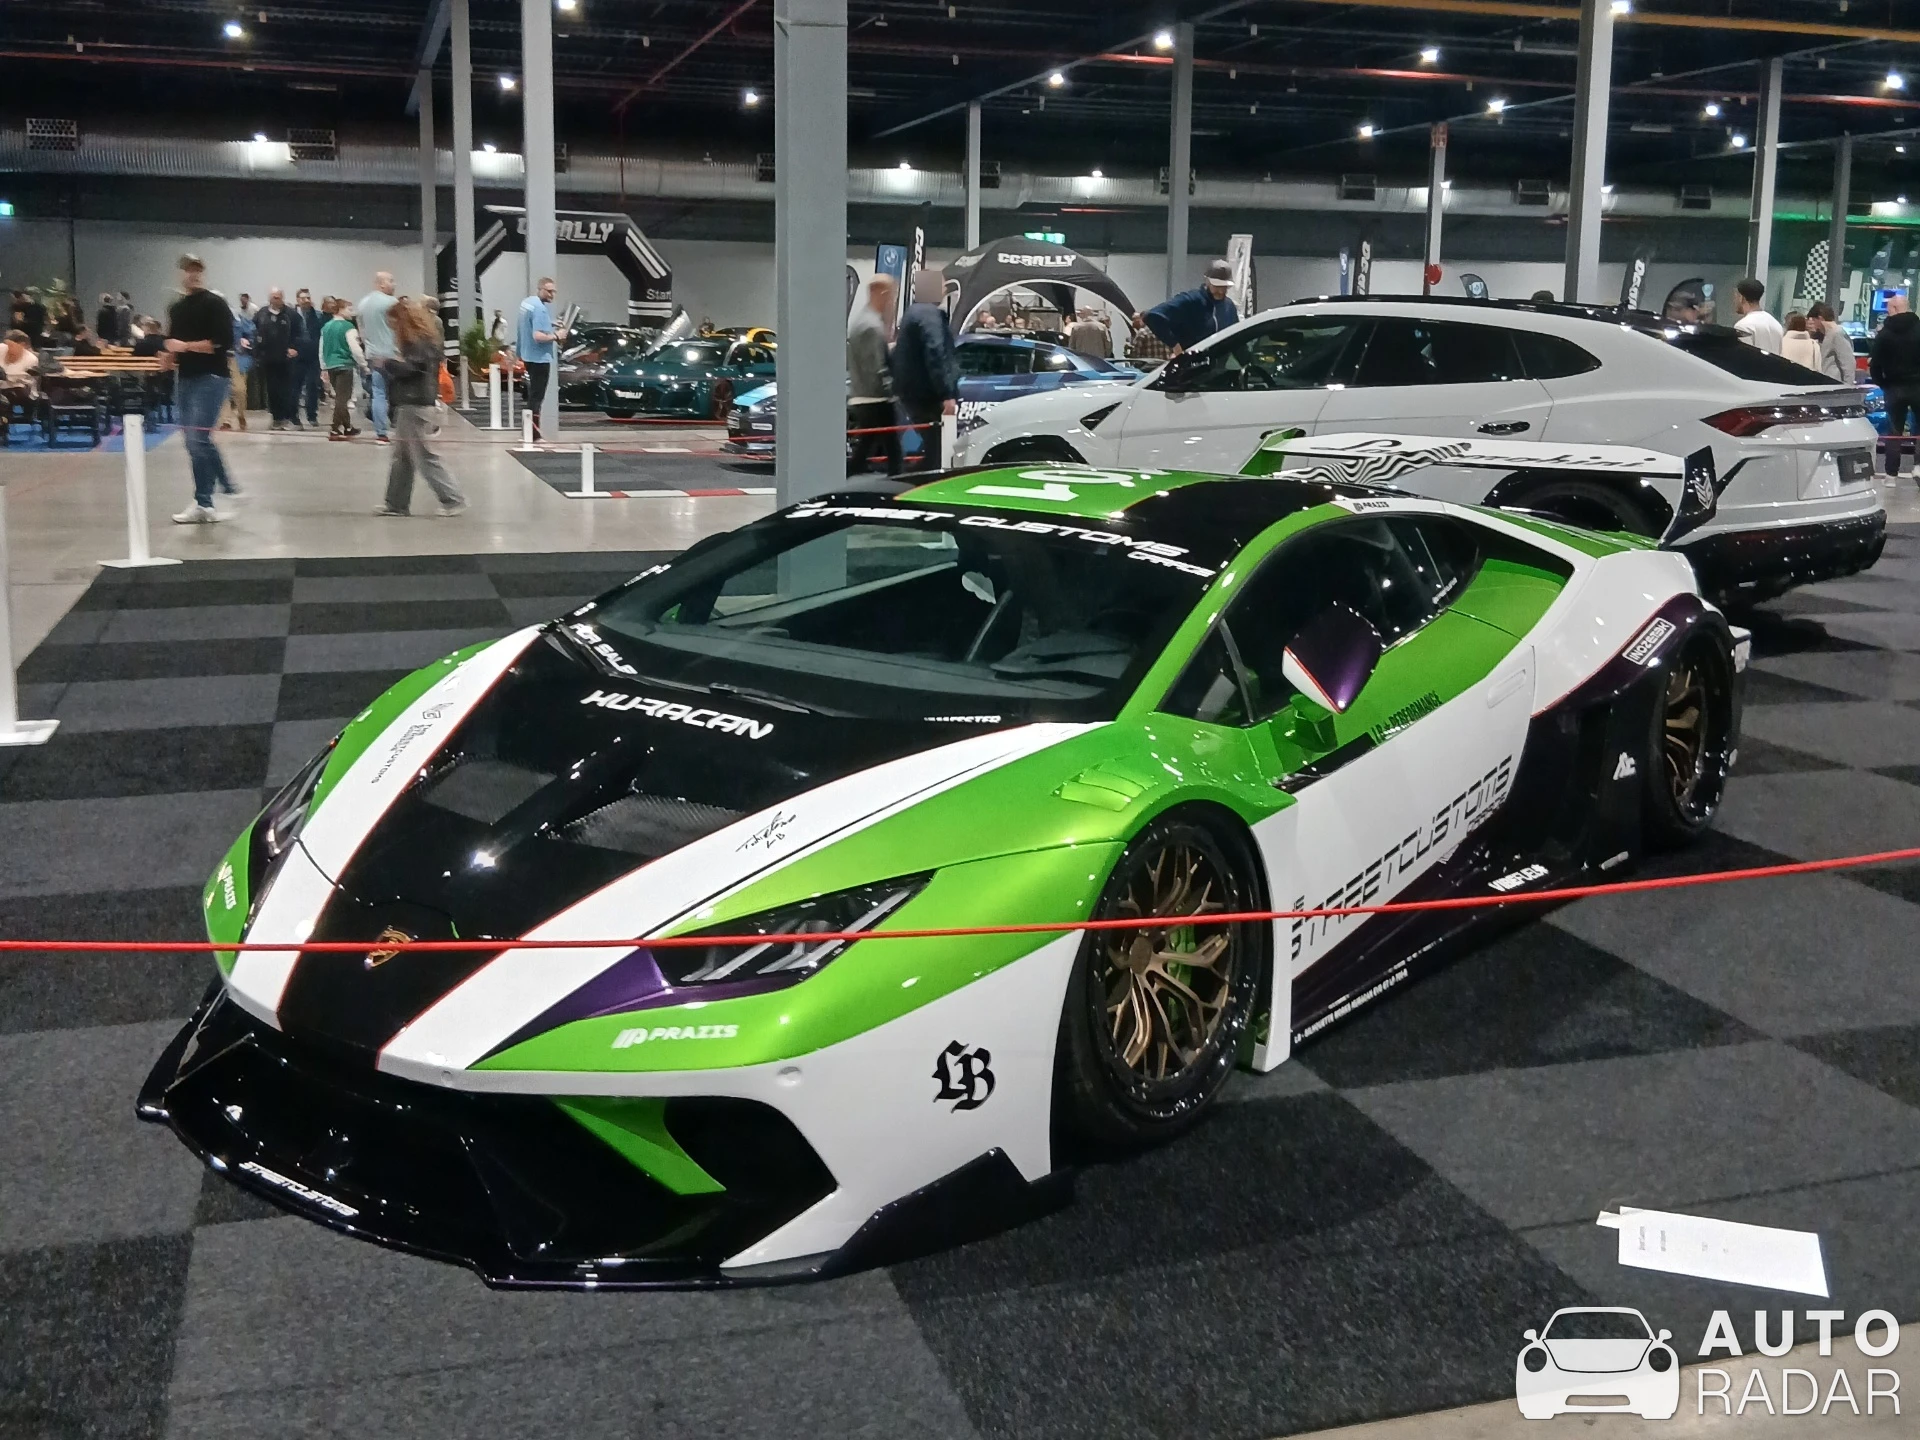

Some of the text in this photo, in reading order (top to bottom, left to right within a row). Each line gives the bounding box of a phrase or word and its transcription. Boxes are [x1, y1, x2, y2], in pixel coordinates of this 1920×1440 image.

[517, 217, 614, 242] CALLY
[785, 507, 1190, 557] STREET CUSTOMS
[1127, 551, 1217, 578] GARAGE
[580, 689, 775, 740] HURACAN
